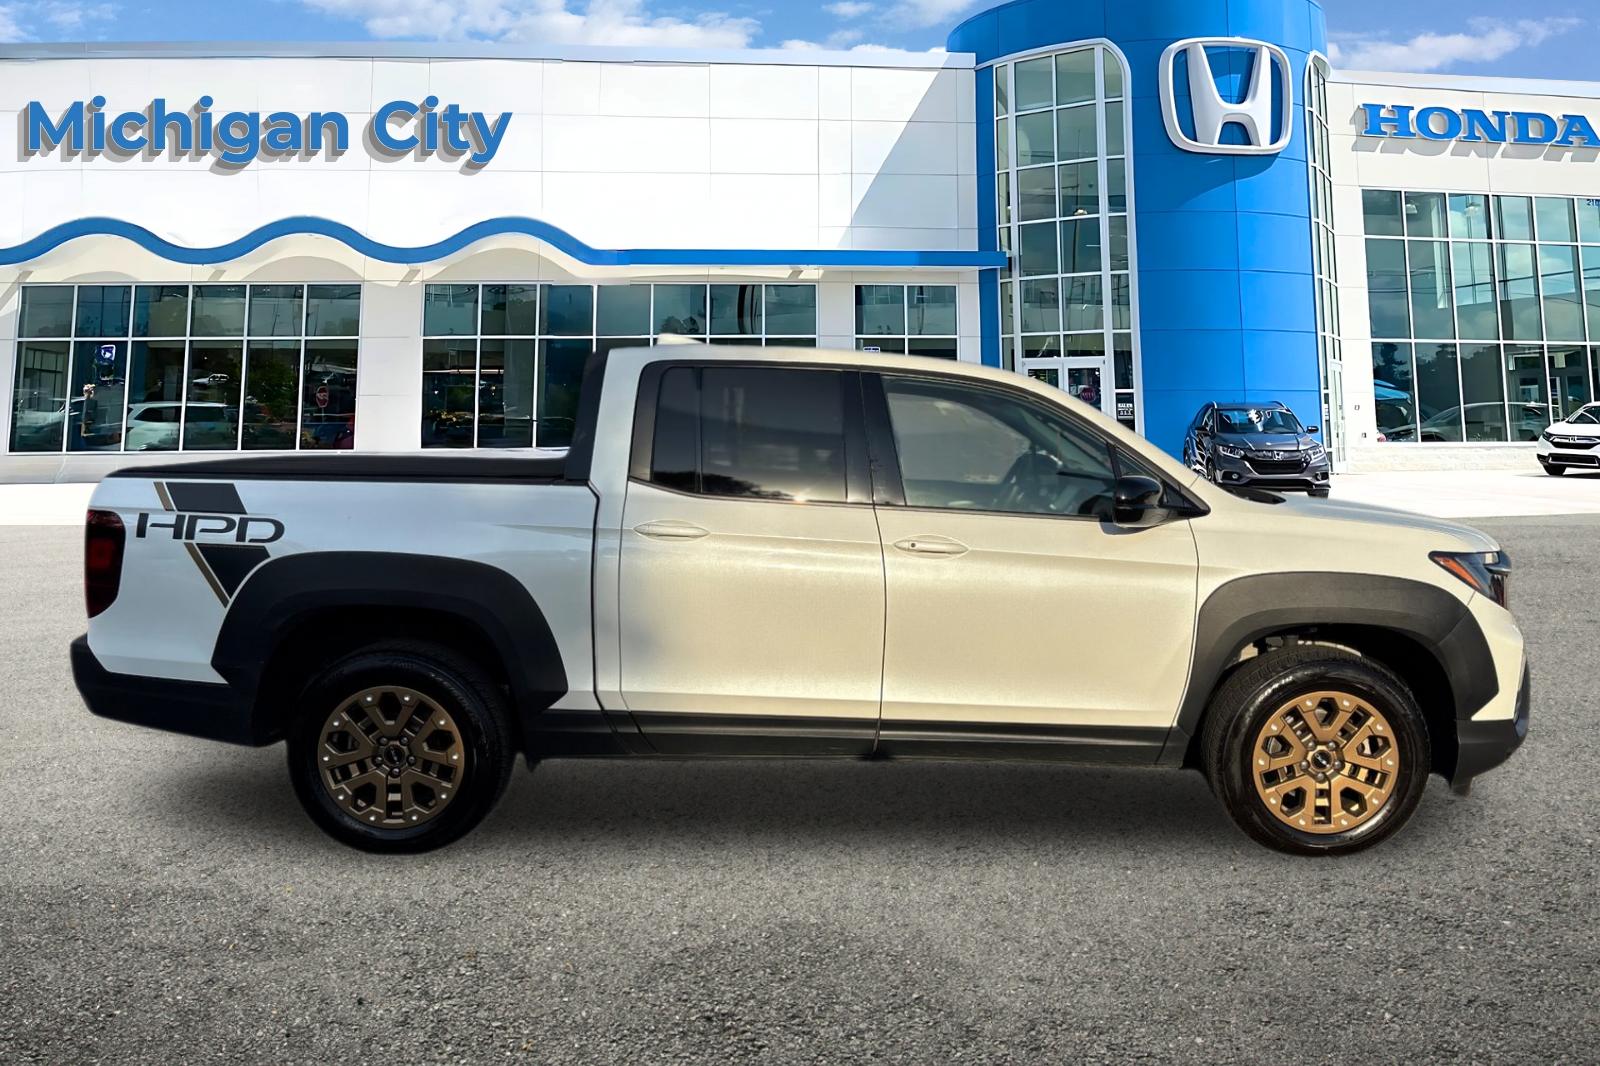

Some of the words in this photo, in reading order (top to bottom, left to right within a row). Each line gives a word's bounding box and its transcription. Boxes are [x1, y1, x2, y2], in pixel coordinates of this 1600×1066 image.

[28, 95, 349, 163] Michigan
[373, 95, 513, 163] City
[1361, 102, 1600, 148] HONDA
[135, 512, 286, 544] HPD
